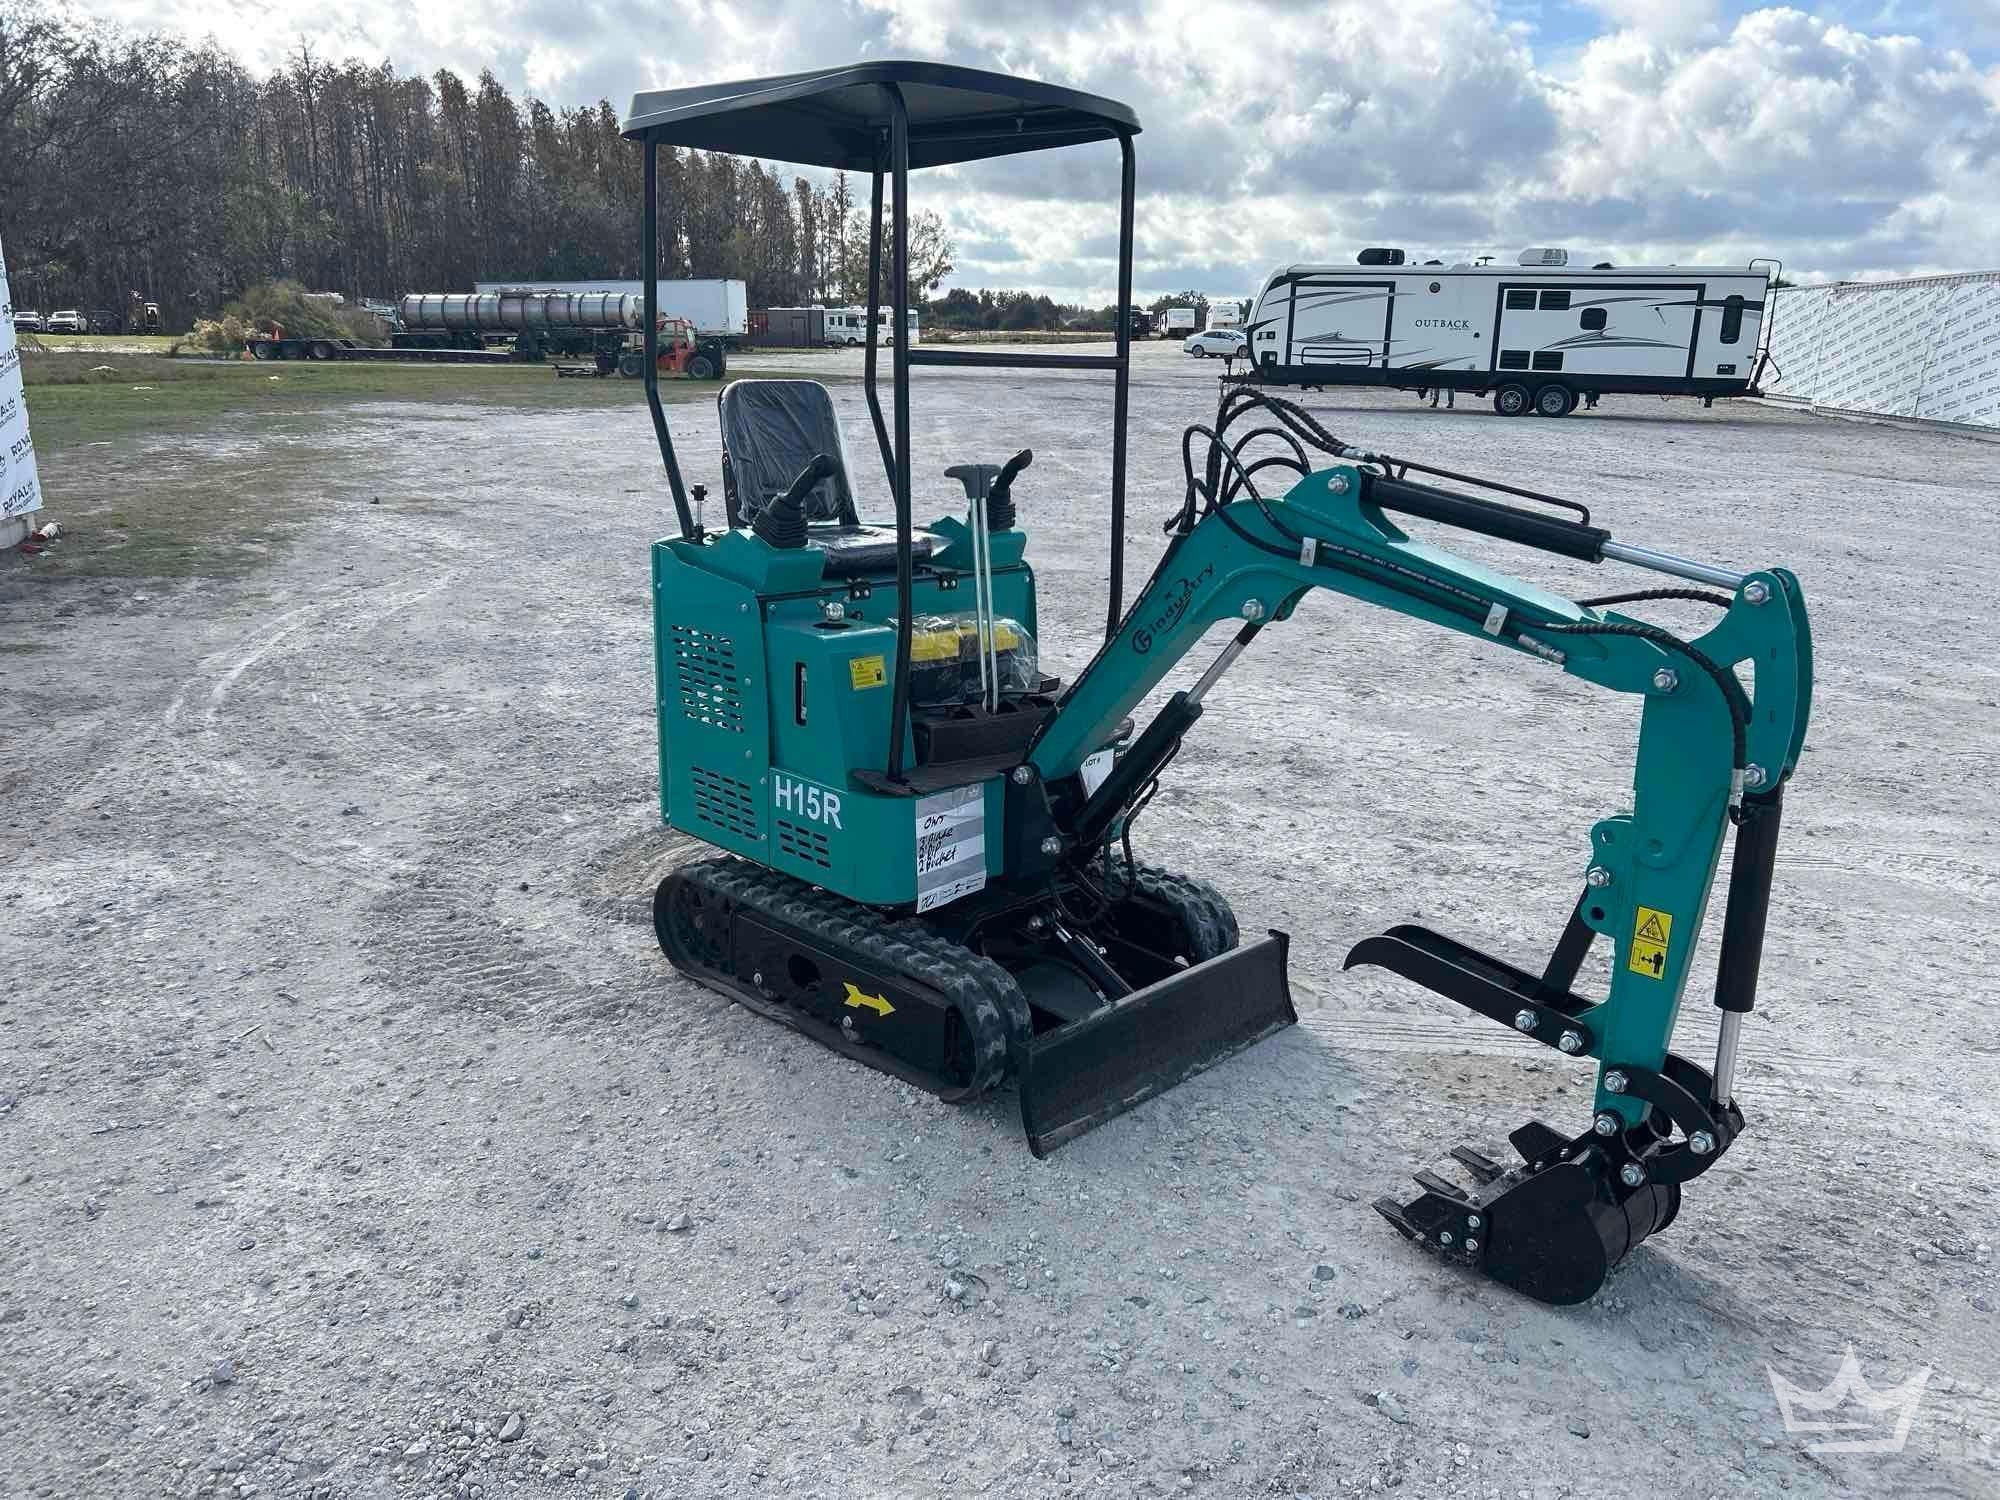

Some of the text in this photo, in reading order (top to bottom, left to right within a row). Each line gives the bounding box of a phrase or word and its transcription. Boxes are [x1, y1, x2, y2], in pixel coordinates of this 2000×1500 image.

[1415, 319, 1469, 328] OUTBACK
[3, 485, 29, 513] ROYAL
[775, 775, 842, 830] H15R
